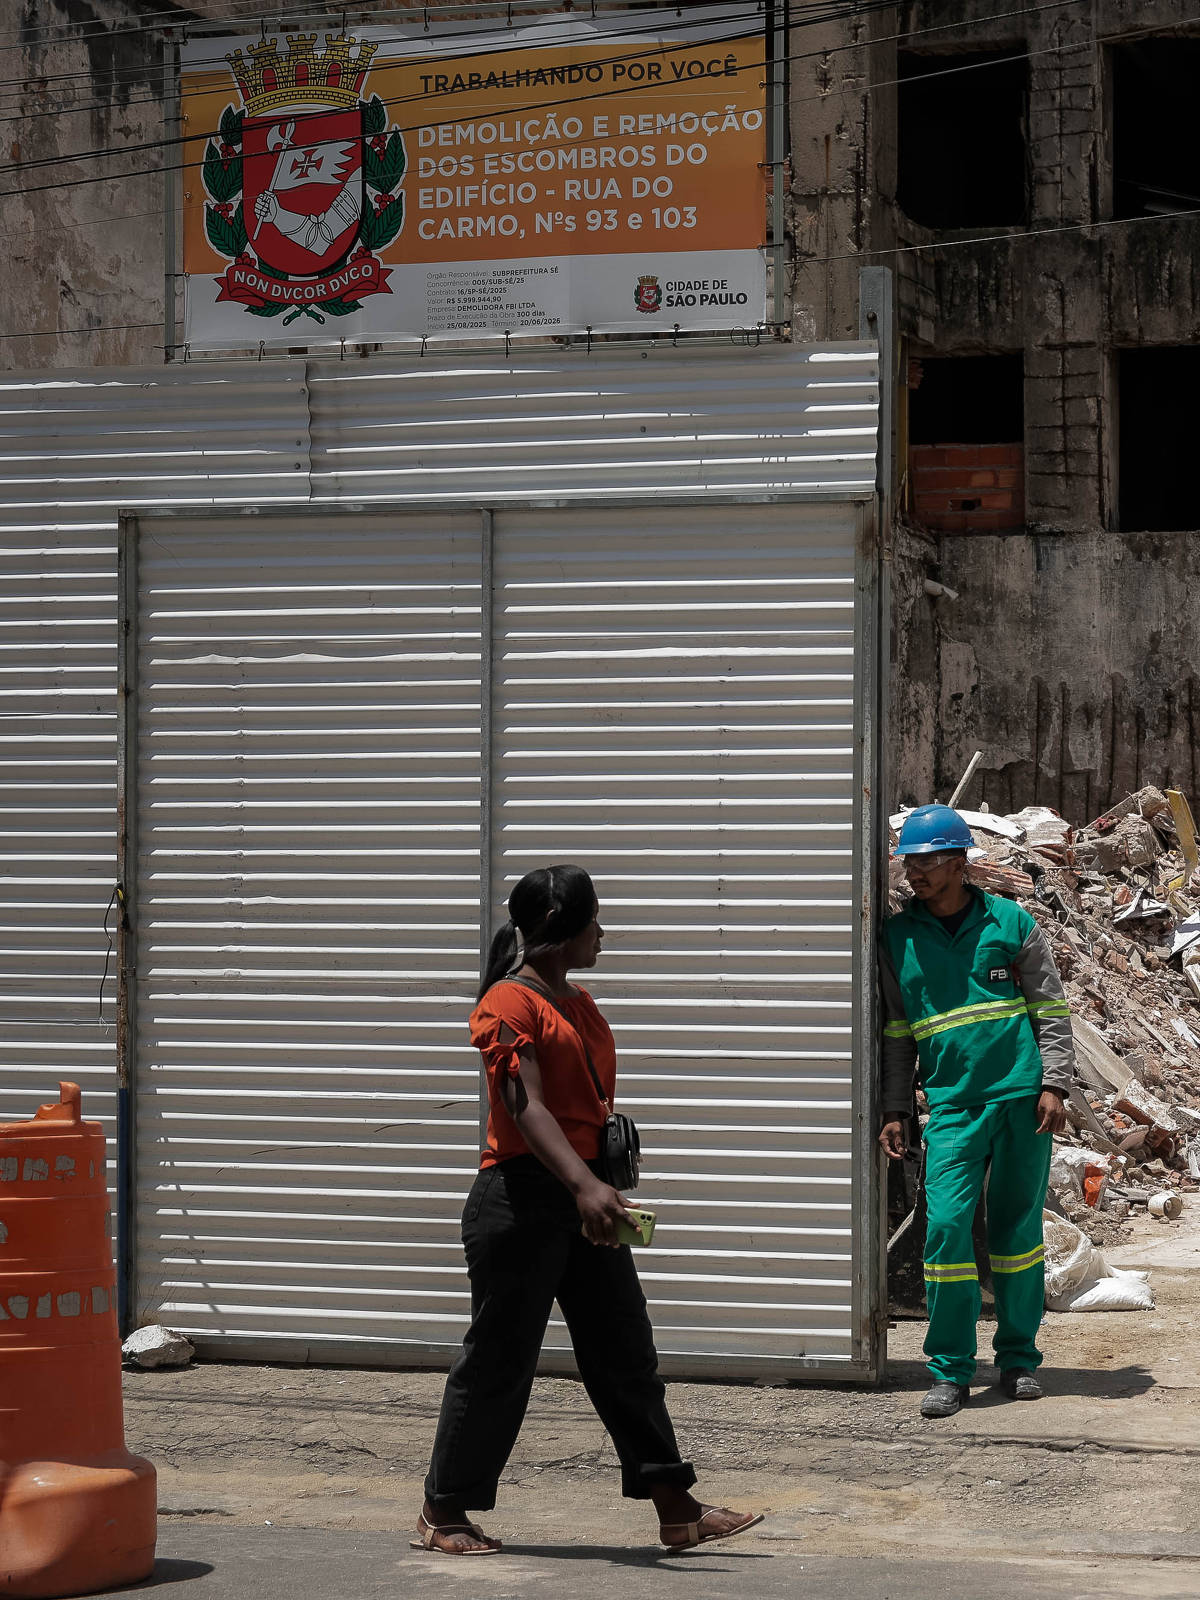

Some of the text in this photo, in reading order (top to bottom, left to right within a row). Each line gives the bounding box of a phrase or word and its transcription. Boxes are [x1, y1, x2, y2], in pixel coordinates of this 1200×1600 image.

[419, 54, 738, 94] TRABALHANDO POR VOCÊ
[418, 104, 763, 148] DEMOLIÇÃO E REMOÇÃO
[418, 142, 708, 179] DOS ESCOMBROS DO
[418, 179, 537, 209] EDIFÍCIO
[564, 177, 622, 201] RUA
[632, 175, 673, 198] DO
[418, 206, 697, 240] CARMO, Nºs 93 e 103
[234, 264, 373, 300] NON DVCOR DVCO
[492, 267, 549, 277] SUBPREFEITURA
[666, 279, 728, 292] CIDADE DE
[457, 295, 502, 304] 5.999.944,90
[457, 302, 503, 312] DEMOLIDORA
[666, 292, 748, 308] SÃO PAULO
[516, 310, 530, 318] 300
[531, 309, 546, 318] dias
